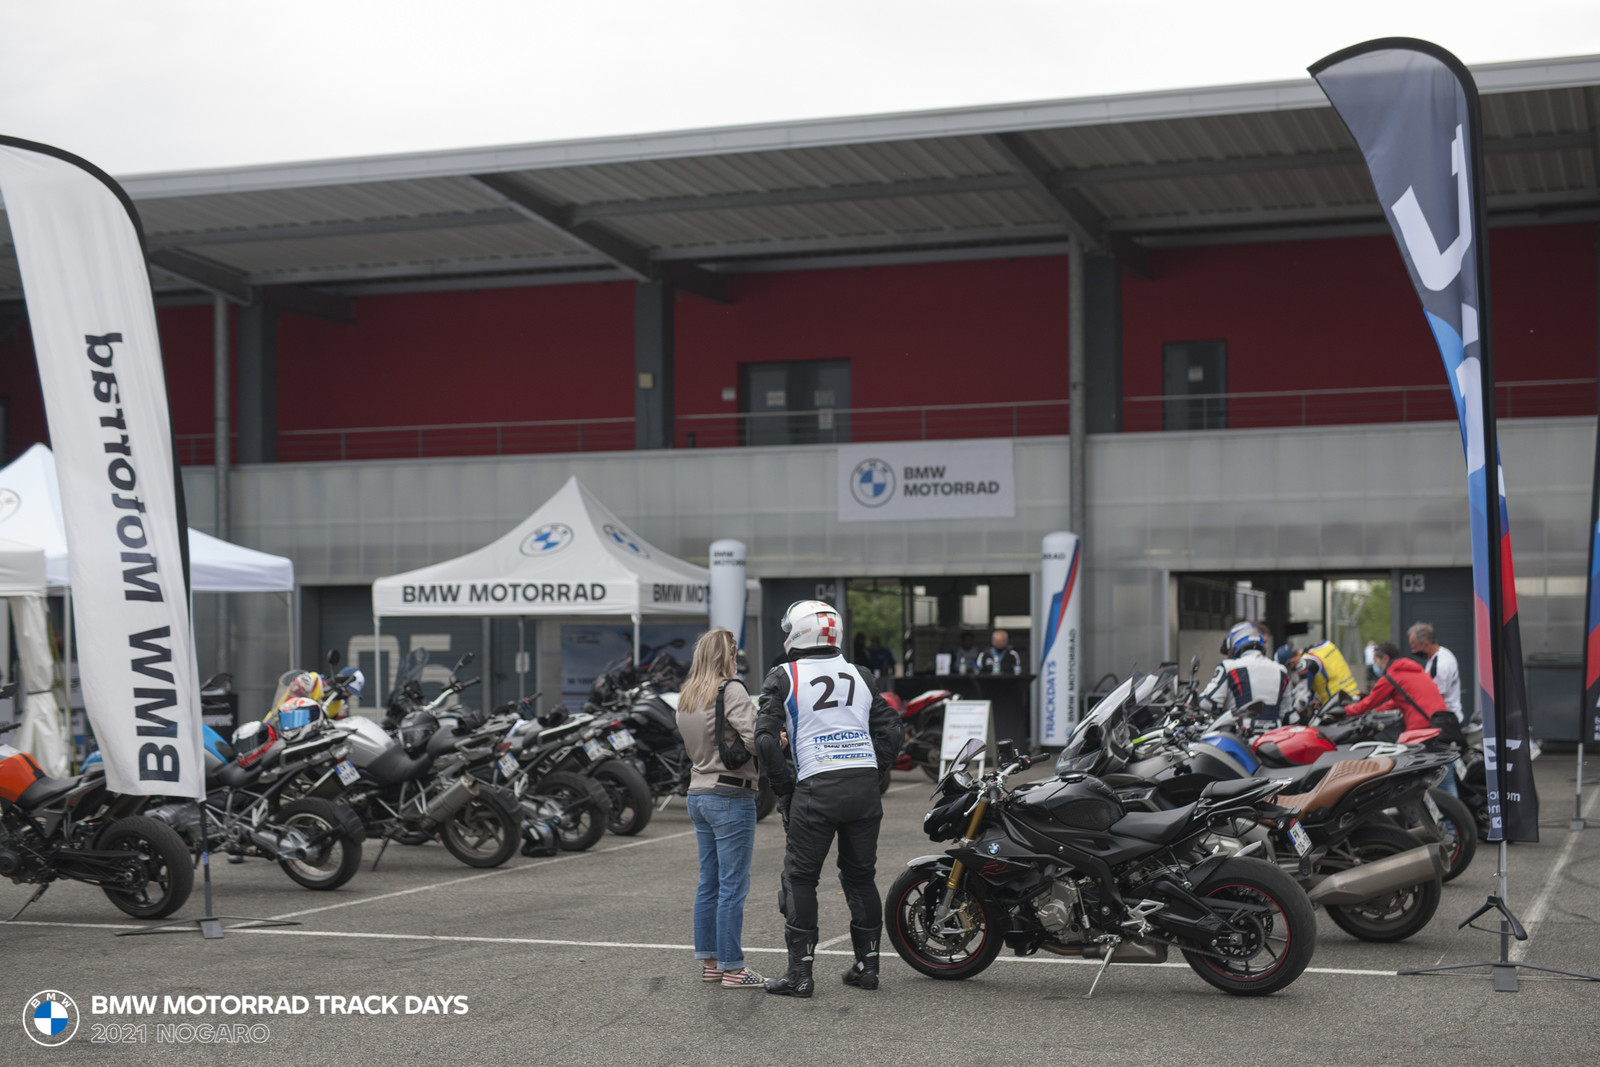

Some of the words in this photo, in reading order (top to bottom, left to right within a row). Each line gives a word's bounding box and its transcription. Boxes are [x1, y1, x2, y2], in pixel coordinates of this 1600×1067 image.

[904, 465, 946, 480] BMW
[904, 481, 1000, 497] MOTORRAD
[402, 584, 461, 603] BMW
[469, 583, 607, 602] MOTORRAD
[653, 583, 682, 602] BMW
[1402, 575, 1425, 593] 03
[809, 672, 856, 711] 27
[1045, 660, 1057, 741] TRACKDAYS
[813, 731, 869, 743] TRACKDAYS
